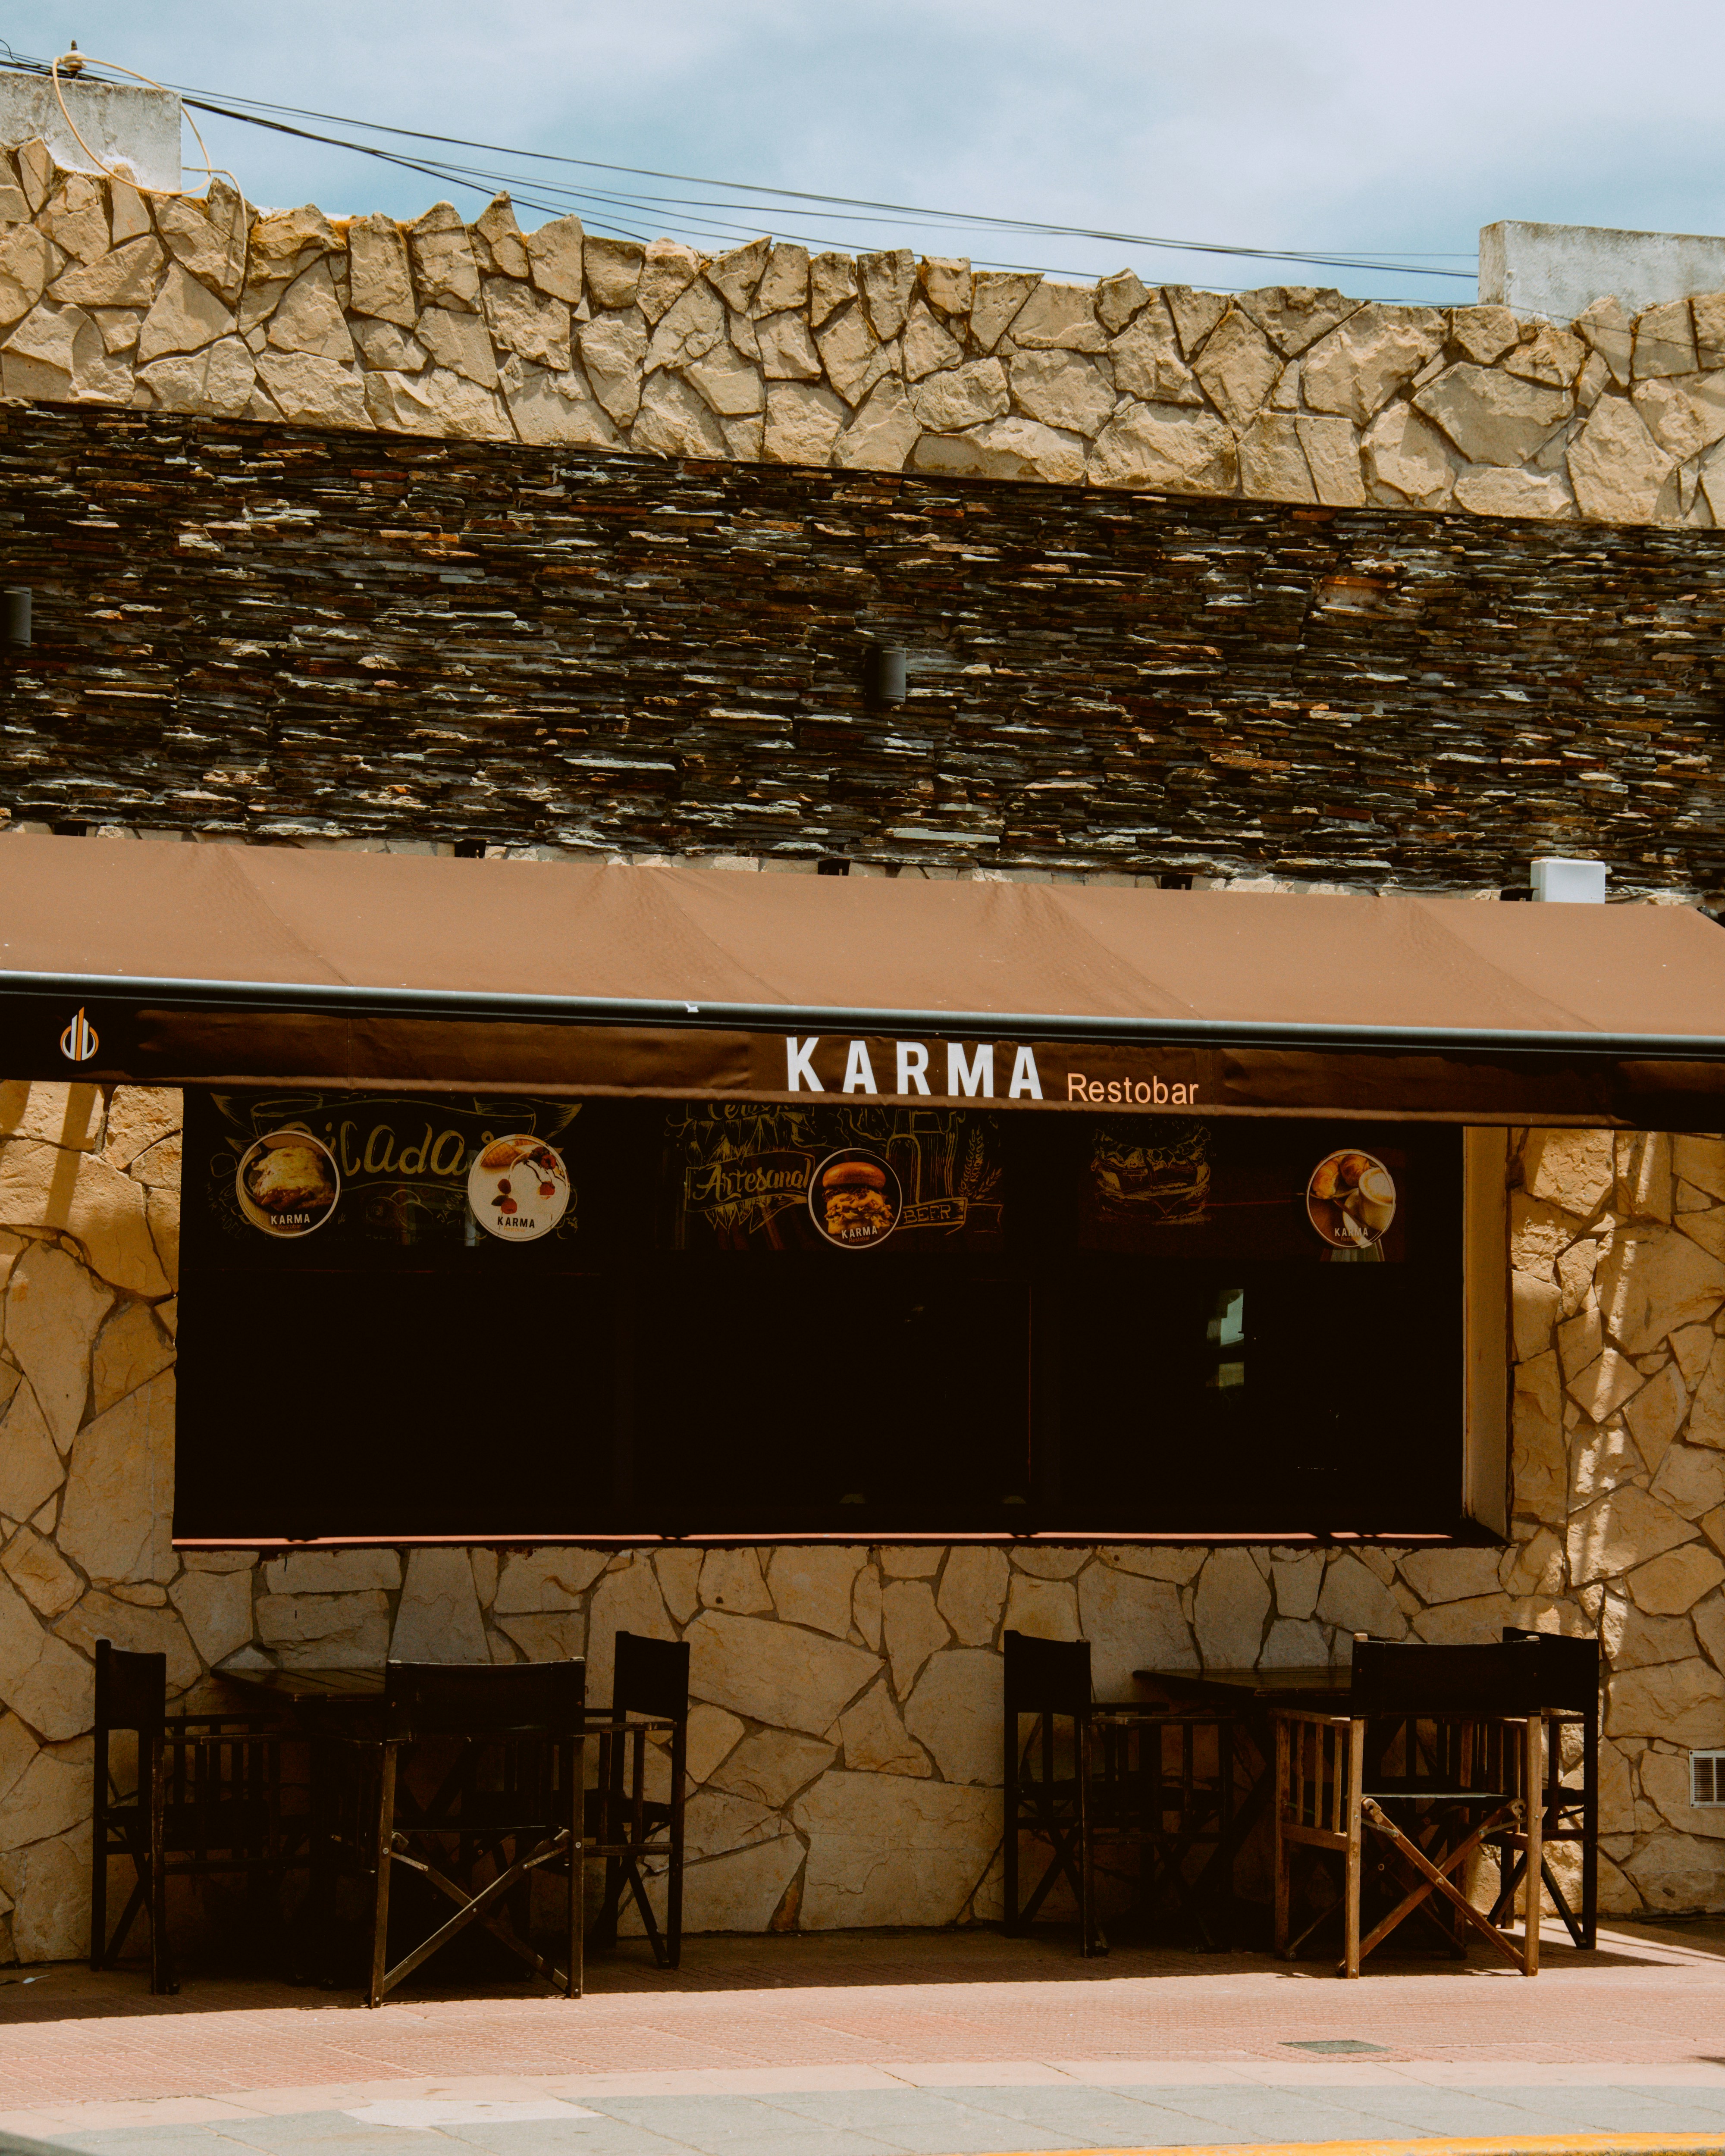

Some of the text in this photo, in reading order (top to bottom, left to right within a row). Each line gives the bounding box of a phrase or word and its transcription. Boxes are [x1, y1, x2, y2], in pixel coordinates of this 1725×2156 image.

[786, 1037, 1199, 1105] KARMA Restobar
[693, 1158, 811, 1202] Artesanal
[271, 1213, 310, 1225] KARMA
[903, 1204, 951, 1225] BEER
[497, 1216, 535, 1228] KARMA
[841, 1225, 878, 1239] KARMA
[1334, 1227, 1368, 1237] KARMA
